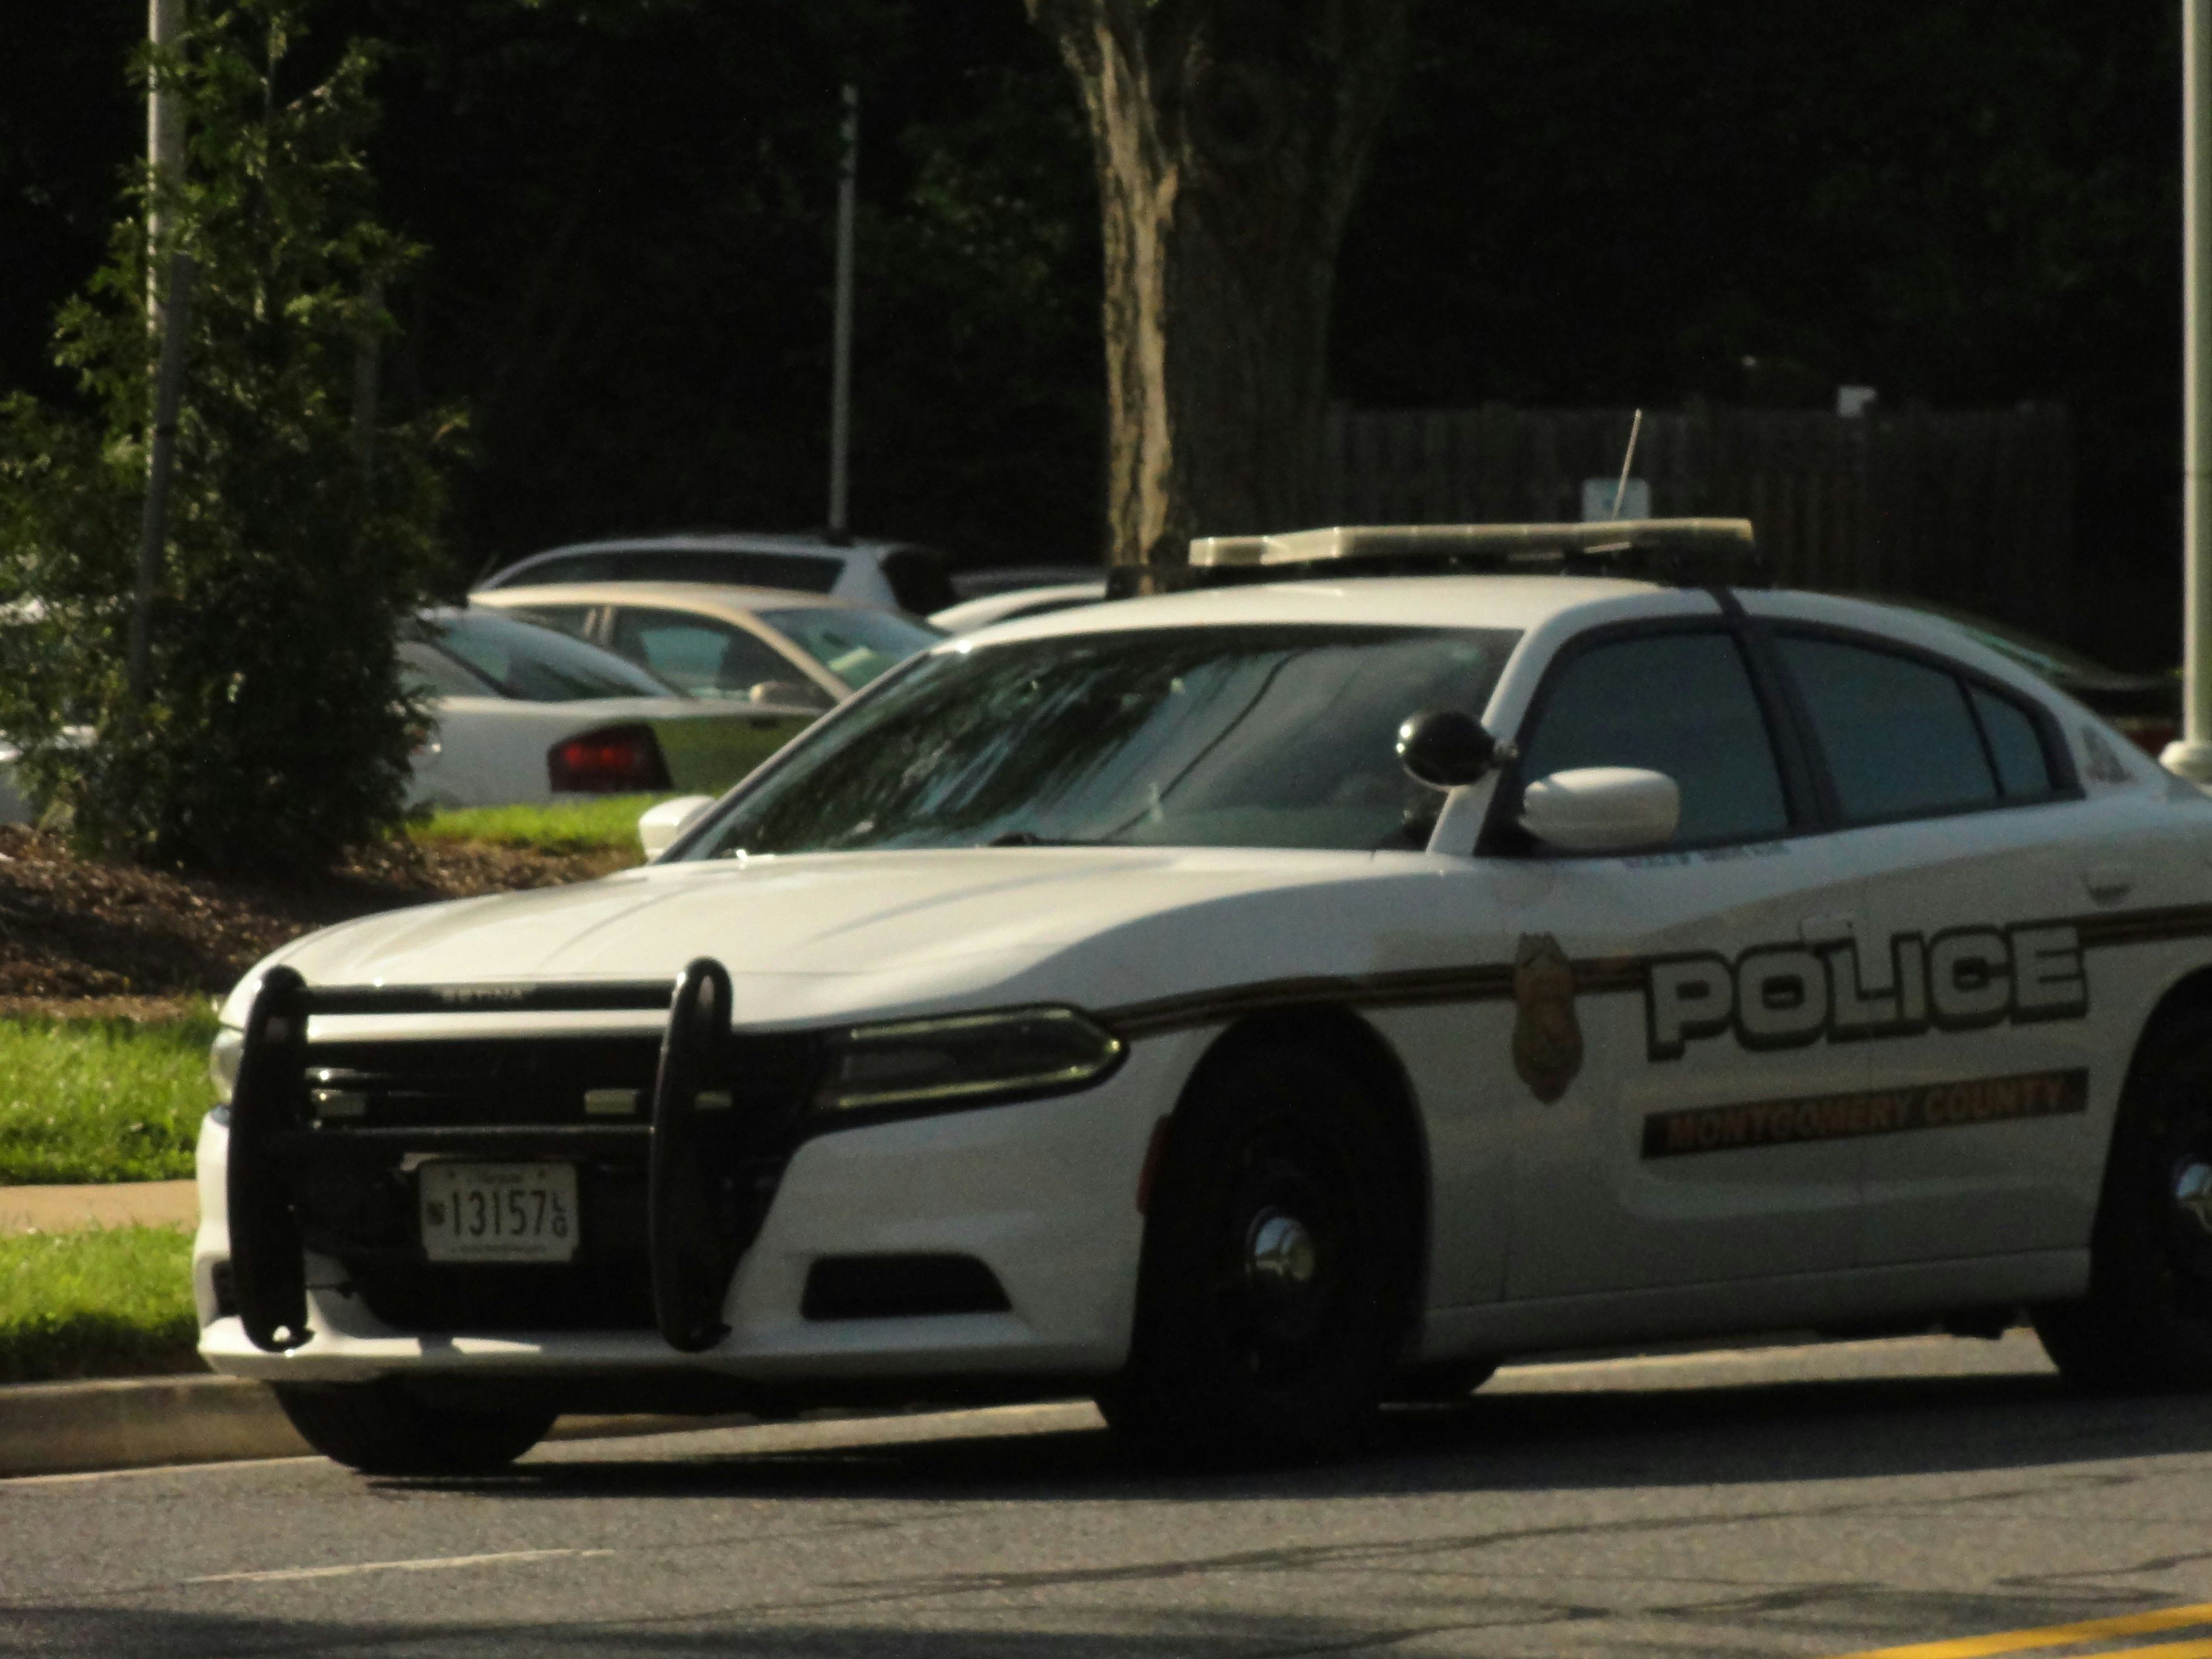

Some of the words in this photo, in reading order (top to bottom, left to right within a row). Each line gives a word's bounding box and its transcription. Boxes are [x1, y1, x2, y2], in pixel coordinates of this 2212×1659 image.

[1647, 925, 2089, 1062] POLICE
[1666, 1093, 1916, 1150] MONTGOMERY
[1923, 1079, 2065, 1125] COUNTY
[451, 1190, 546, 1236] 13157
